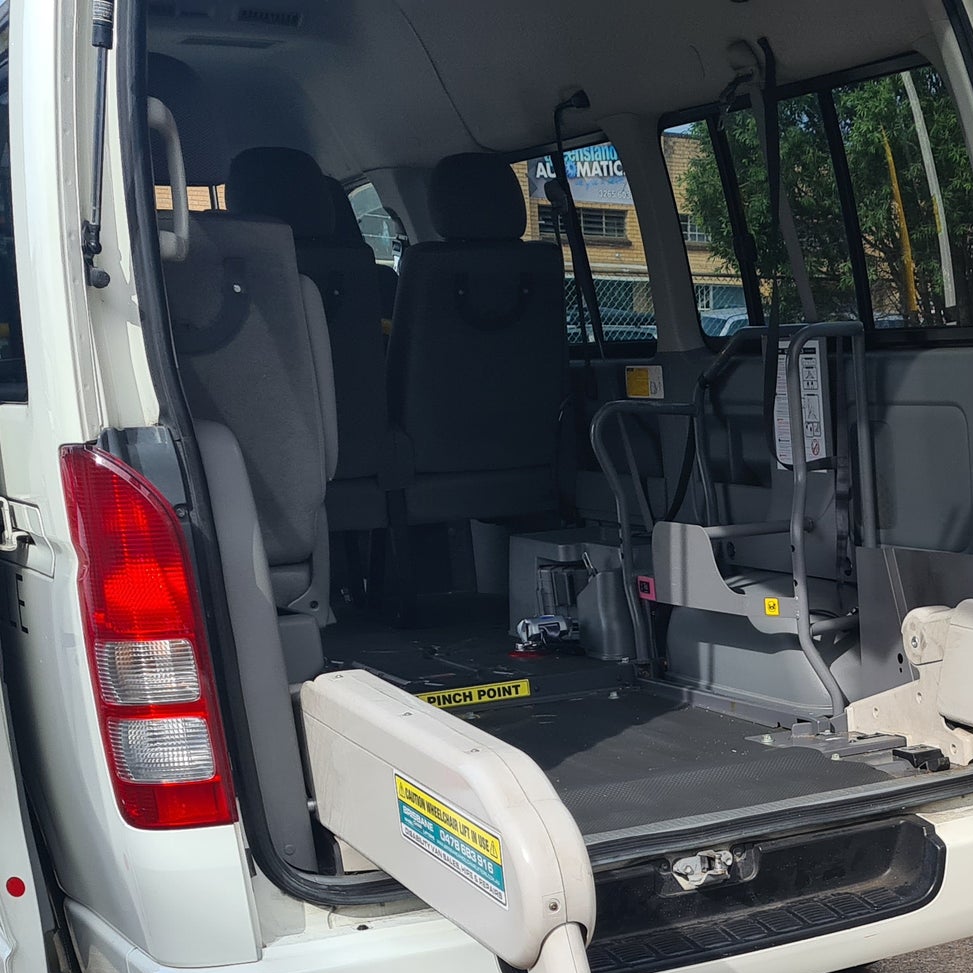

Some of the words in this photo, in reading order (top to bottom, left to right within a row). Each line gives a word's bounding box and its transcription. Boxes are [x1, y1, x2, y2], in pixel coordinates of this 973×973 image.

[427, 691, 473, 706] PINCH
[477, 685, 521, 700] POINT
[439, 829, 461, 851] 0478
[461, 843, 477, 861] 683
[477, 855, 494, 874] 916
